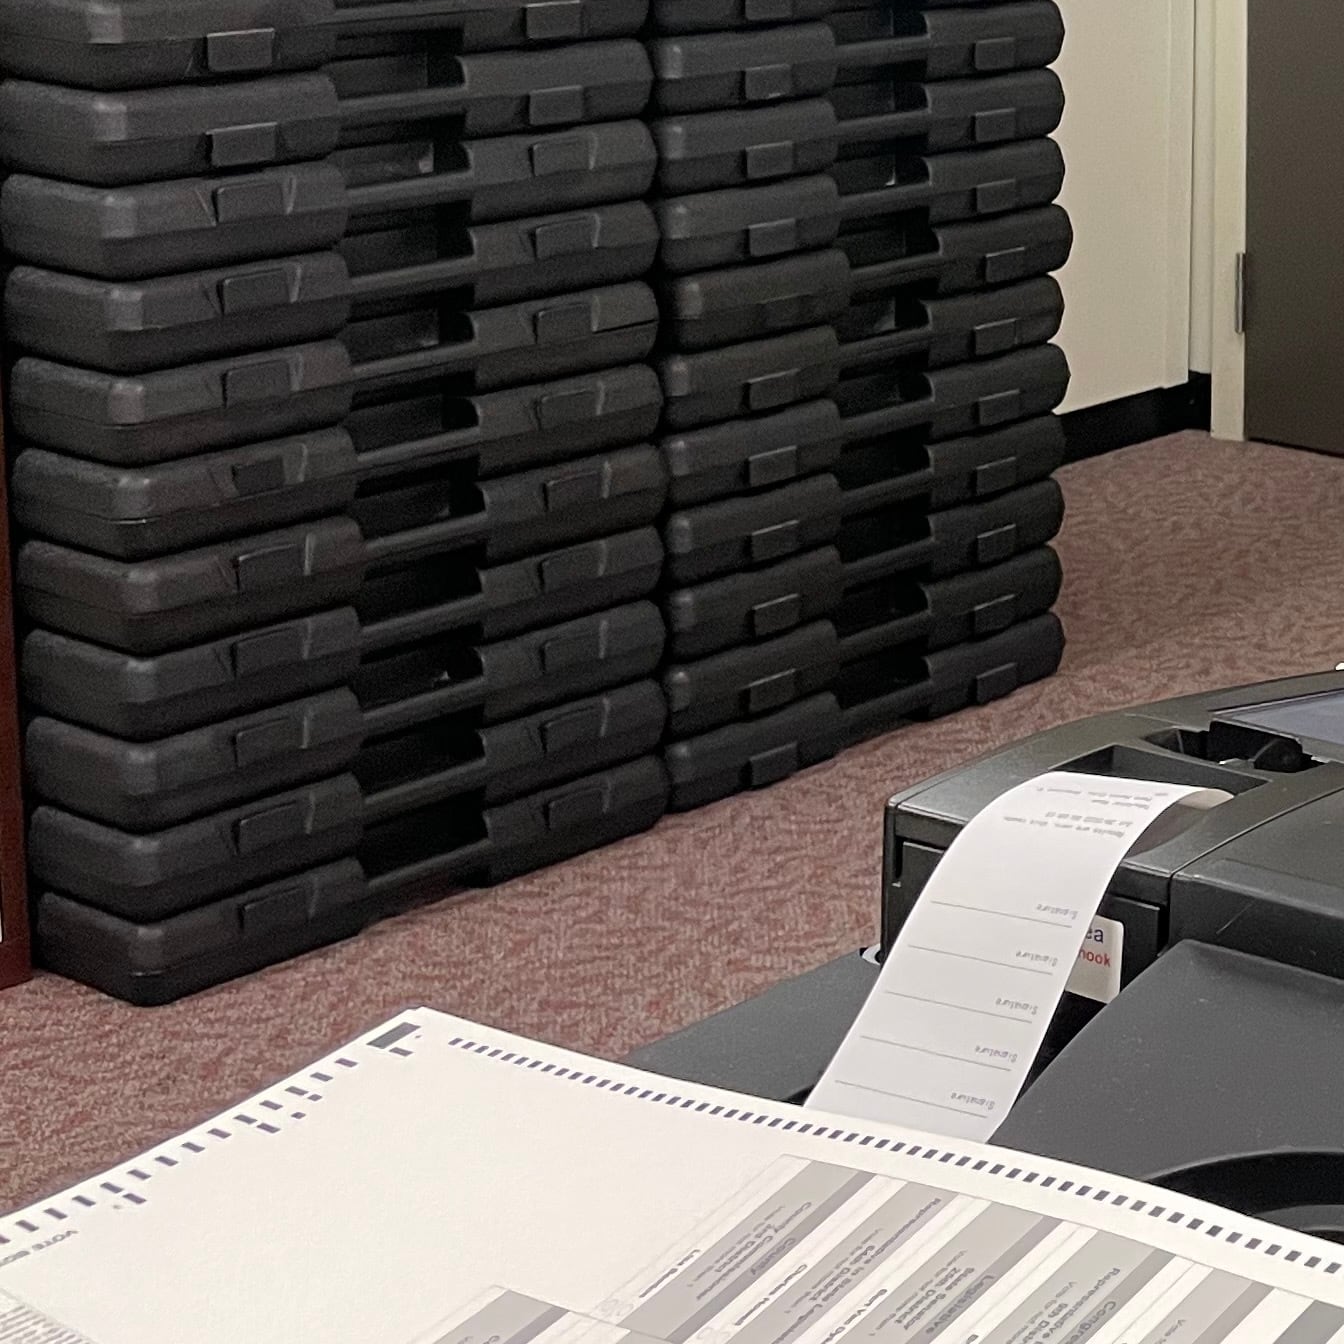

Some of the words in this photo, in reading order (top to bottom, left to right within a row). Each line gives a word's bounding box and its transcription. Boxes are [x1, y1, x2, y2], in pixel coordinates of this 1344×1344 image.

[1037, 903, 1079, 921] Signature
[1015, 950, 1058, 967] Signature
[995, 997, 1039, 1015] Signature
[974, 1045, 1018, 1063] Signature
[950, 1092, 995, 1110] Signature
[775, 1202, 812, 1233] County
[864, 1197, 942, 1265] Representative
[32, 1230, 79, 1251] VOTE
[696, 1235, 774, 1300] Commissioner
[751, 1238, 796, 1275] County
[769, 1264, 808, 1296] Charles
[811, 1268, 850, 1301] District
[822, 1279, 852, 1302] State
[945, 1268, 975, 1291] State
[895, 1289, 936, 1324] District
[904, 1293, 947, 1330] Senator
[926, 1274, 996, 1334] Legislative
[1041, 1268, 1121, 1339] Representative
